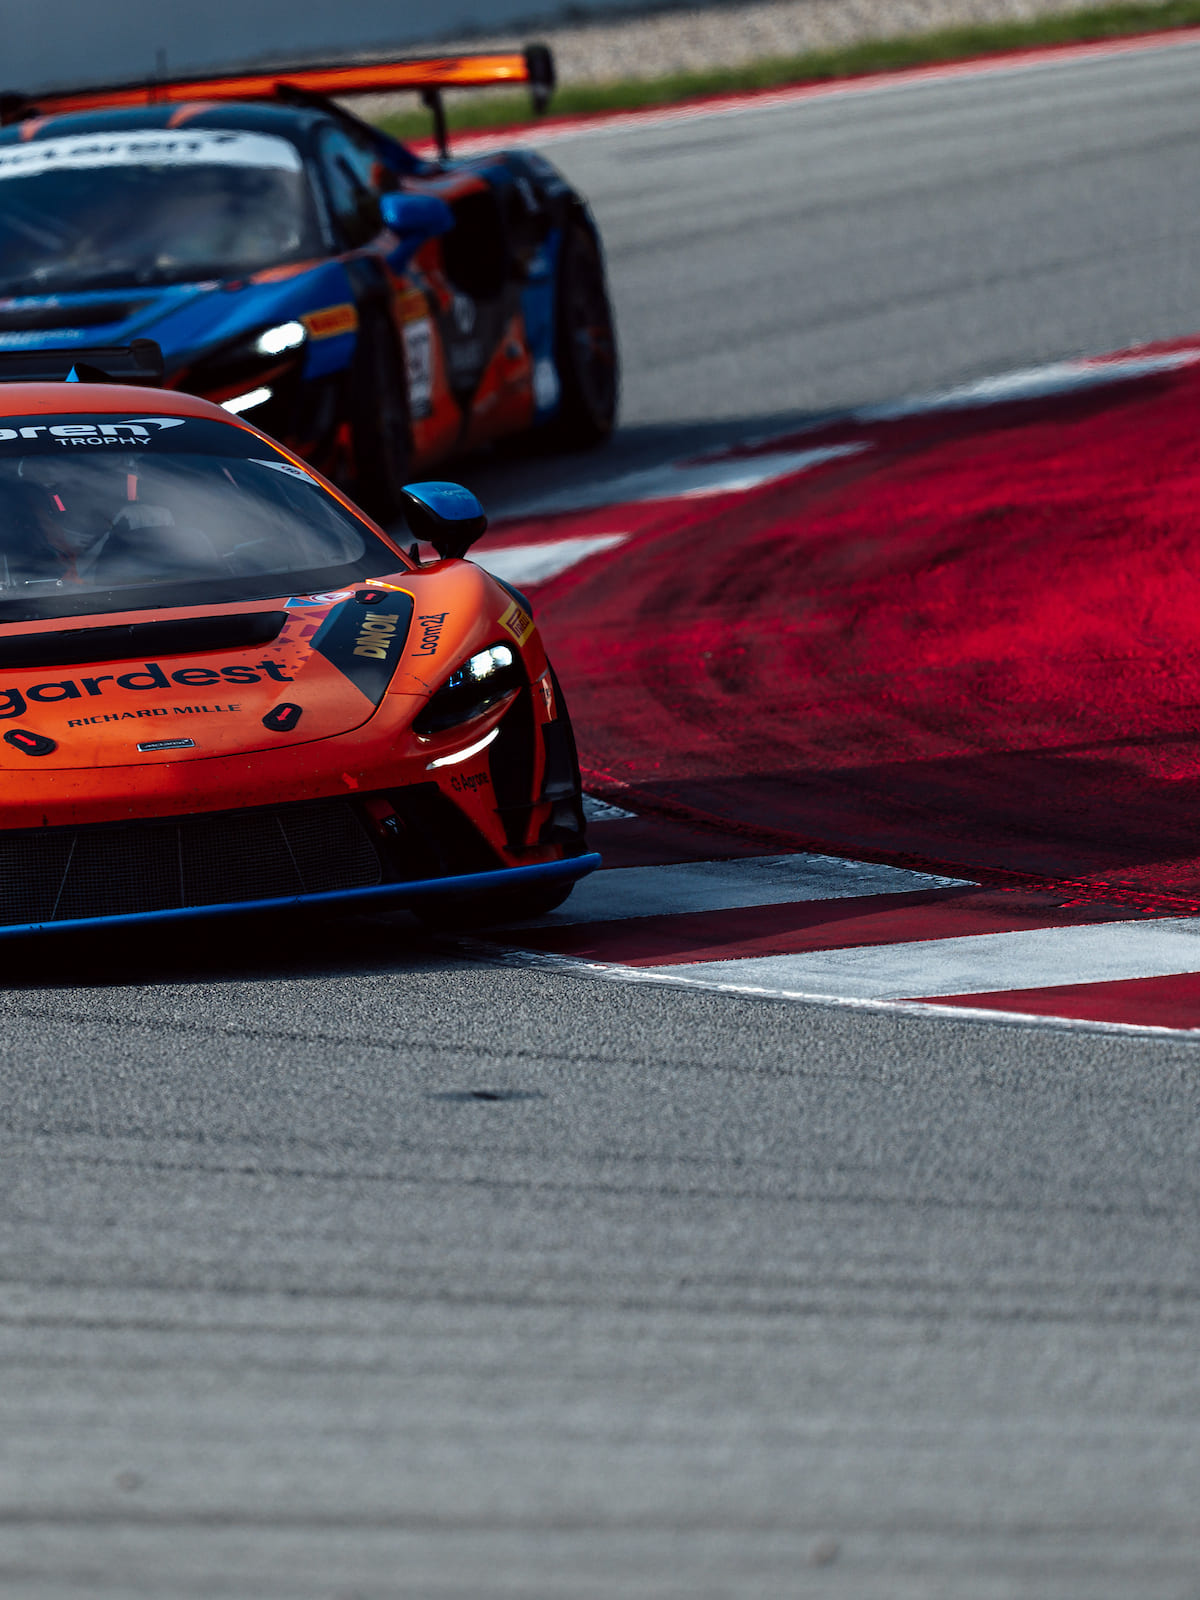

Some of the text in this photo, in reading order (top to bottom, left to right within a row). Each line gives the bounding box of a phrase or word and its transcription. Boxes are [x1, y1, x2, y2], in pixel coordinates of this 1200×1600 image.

[55, 437, 151, 446] TROPHY
[353, 613, 400, 660] DINOIL
[411, 612, 450, 656] Loom24
[506, 607, 530, 638] PIRELLI
[67, 704, 242, 728] RICHARD MILLE
